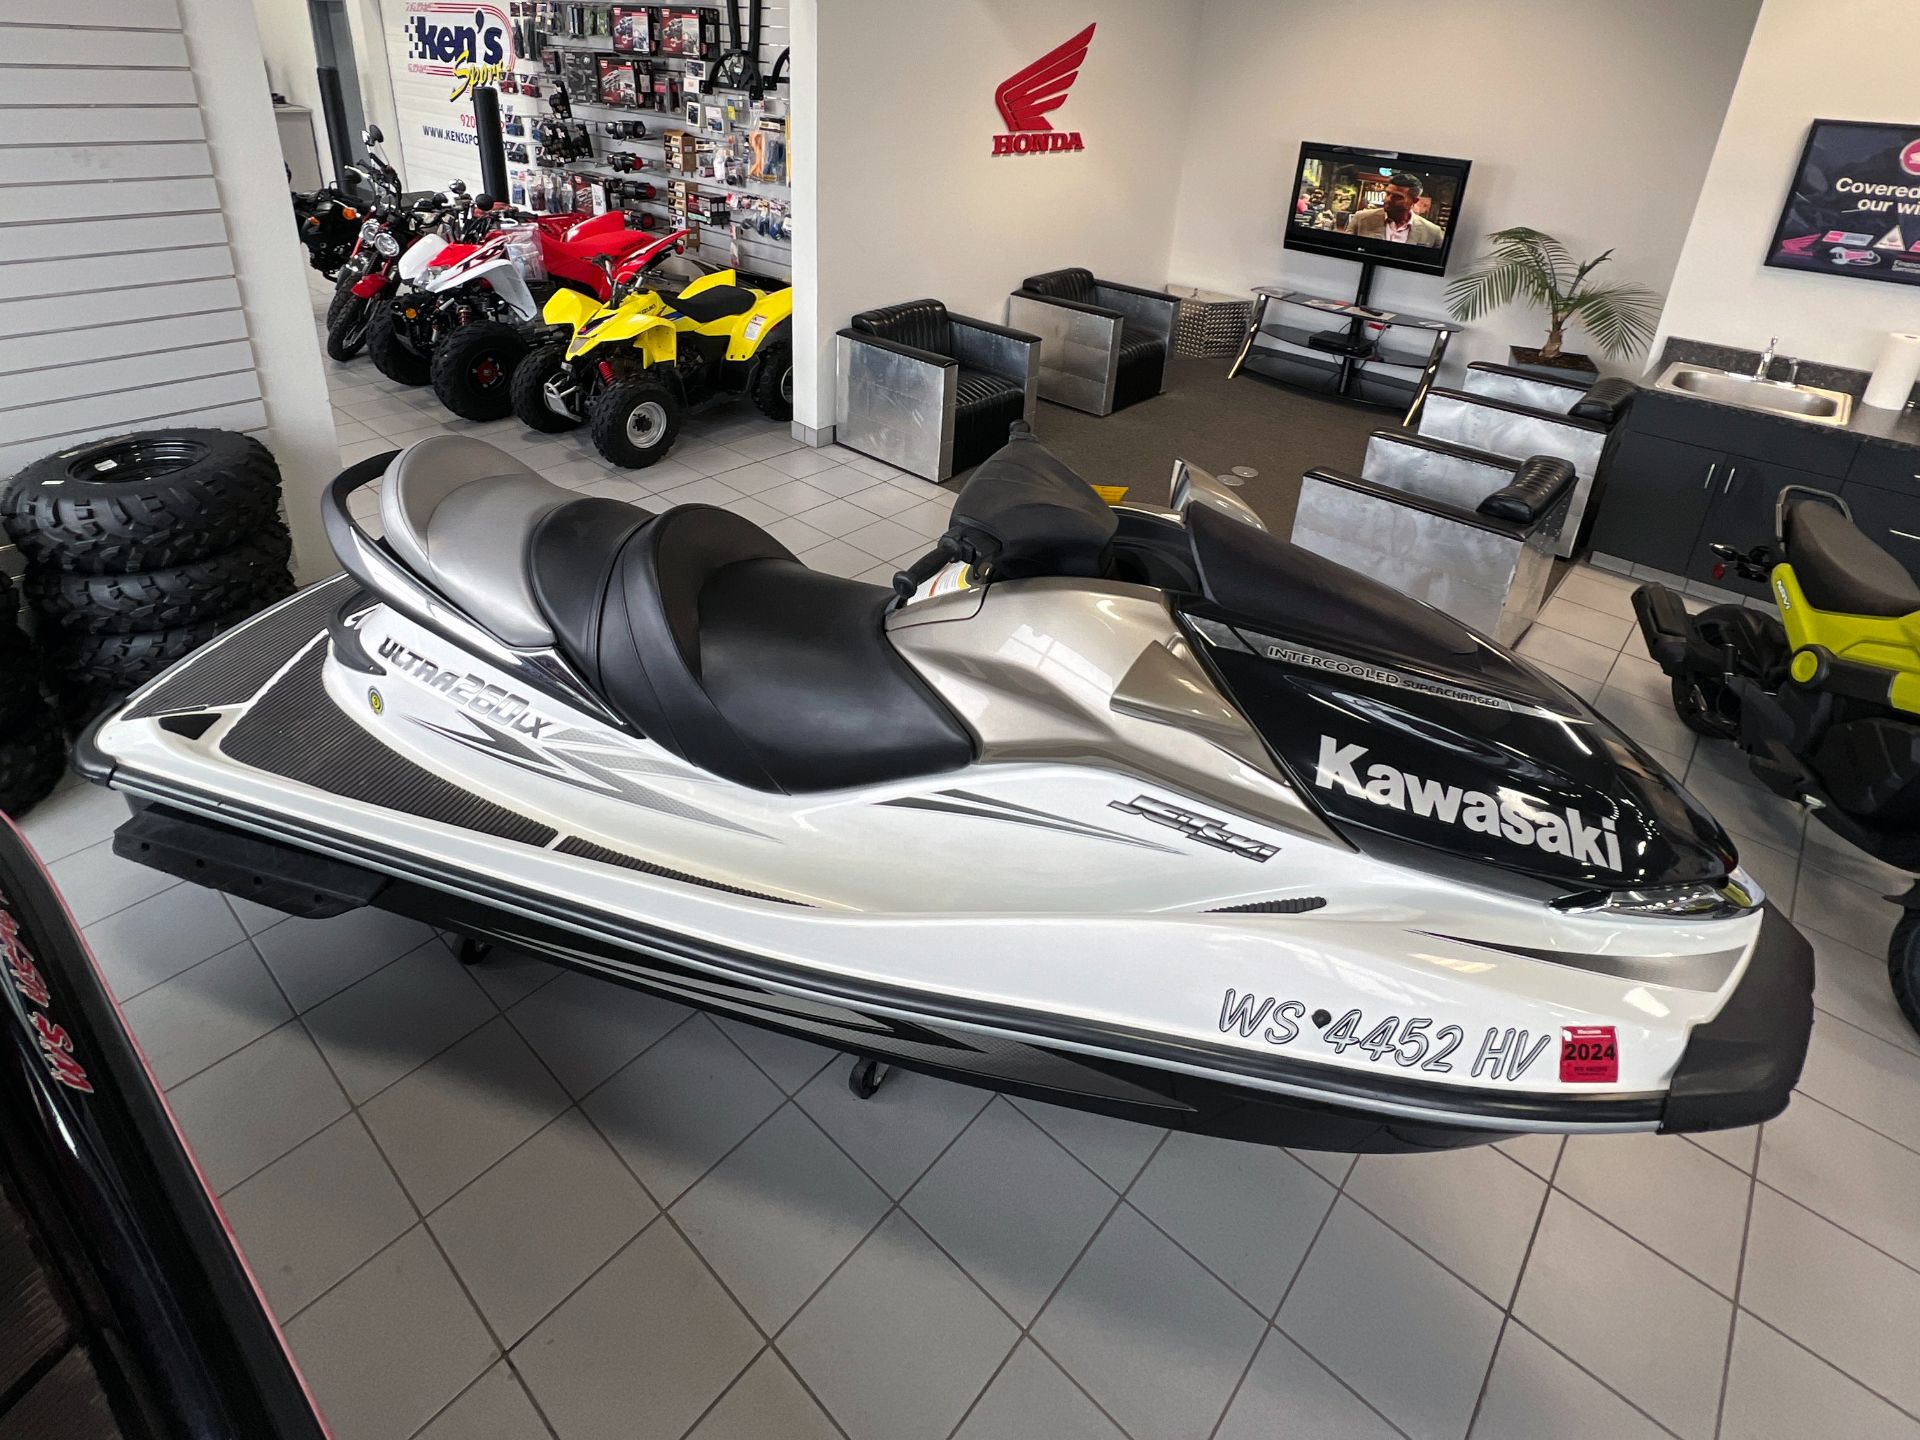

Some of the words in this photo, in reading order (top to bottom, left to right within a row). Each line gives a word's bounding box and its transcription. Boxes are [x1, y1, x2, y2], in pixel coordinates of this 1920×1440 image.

[415, 9, 503, 66] ken's
[422, 125, 479, 146] WWW.KENSSPO
[991, 132, 1085, 155] HONDA
[1835, 177, 1920, 198] Covered
[1857, 198, 1893, 212] our
[1267, 646, 1400, 686] INTERCOOLED
[1402, 678, 1501, 707] SUPERCHARGED
[1315, 734, 1623, 873] Kawasaki
[1218, 988, 1305, 1045] WS
[1322, 1009, 1464, 1074] 4452
[1470, 1026, 1551, 1081] HV
[1564, 1043, 1615, 1060] 2024
